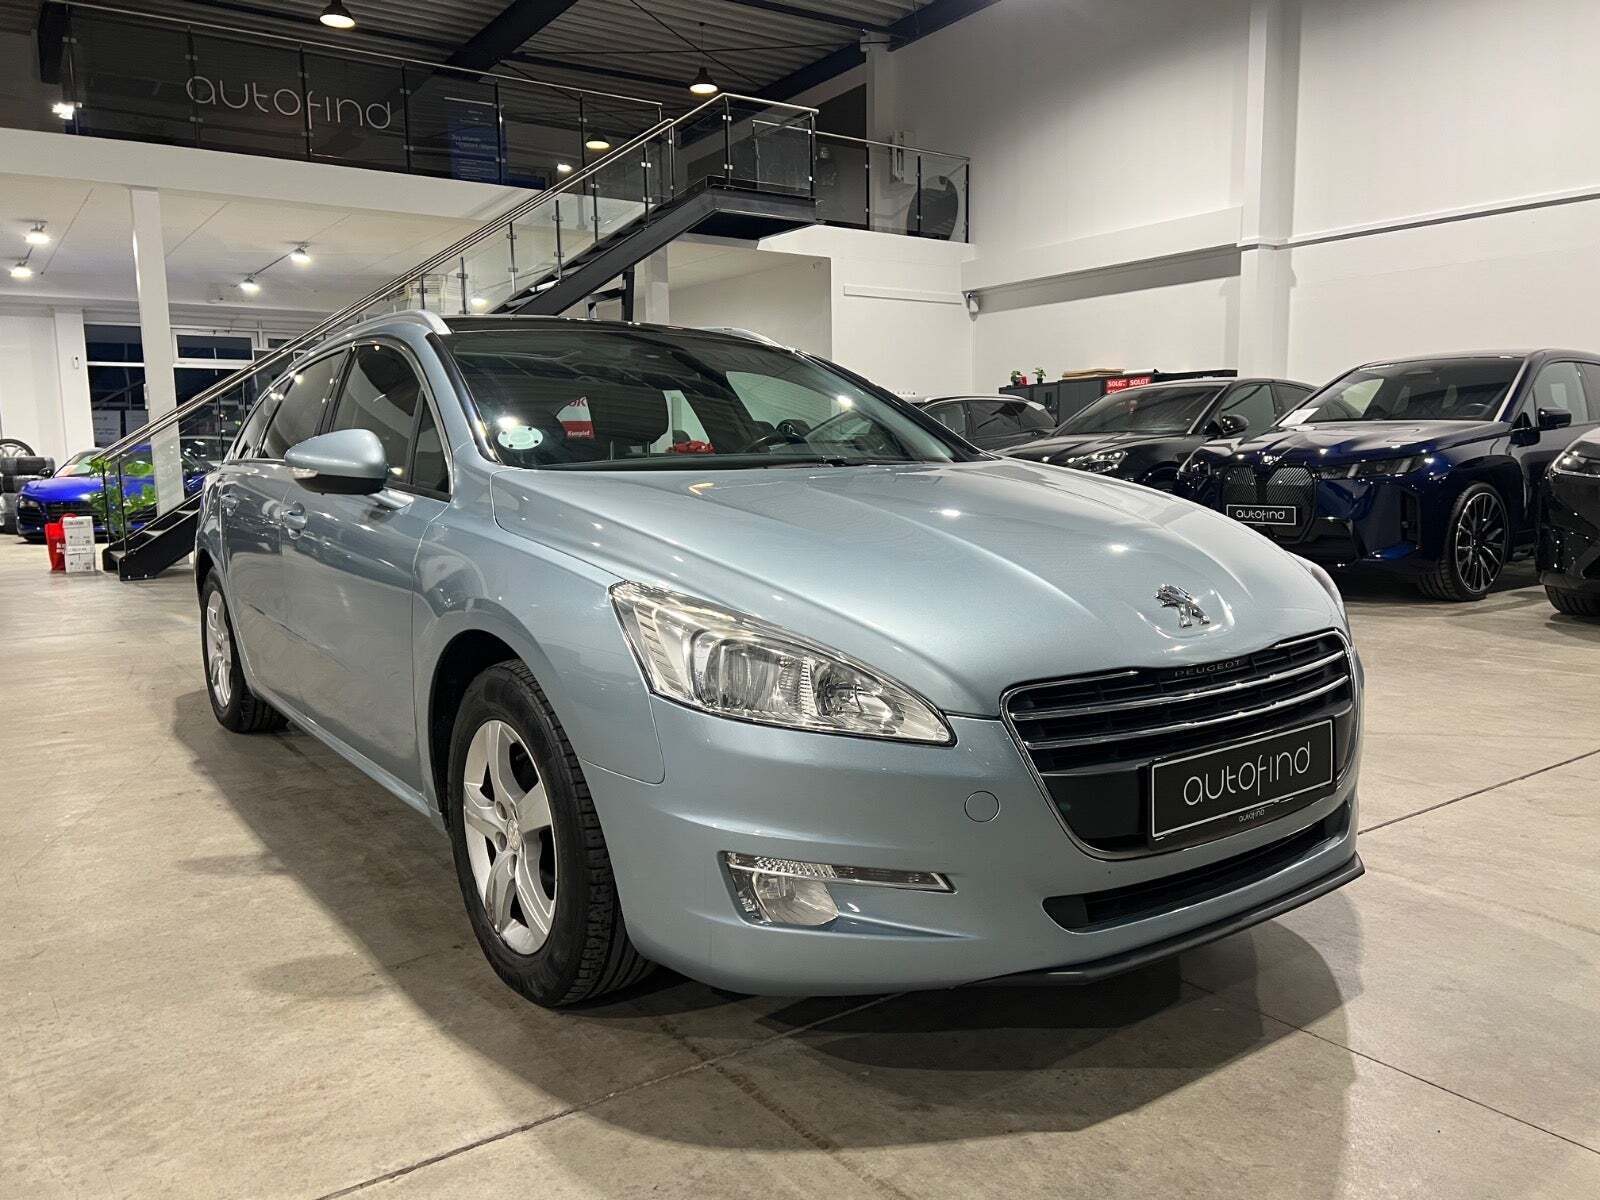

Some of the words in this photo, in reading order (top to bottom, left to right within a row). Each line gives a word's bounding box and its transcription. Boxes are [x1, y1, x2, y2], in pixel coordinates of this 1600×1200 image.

[186, 75, 391, 130] autofind
[1129, 378, 1149, 386] SOLGT
[1236, 509, 1285, 521] autofind
[1174, 659, 1241, 677] PEUGEOT
[1183, 740, 1310, 806] autofind
